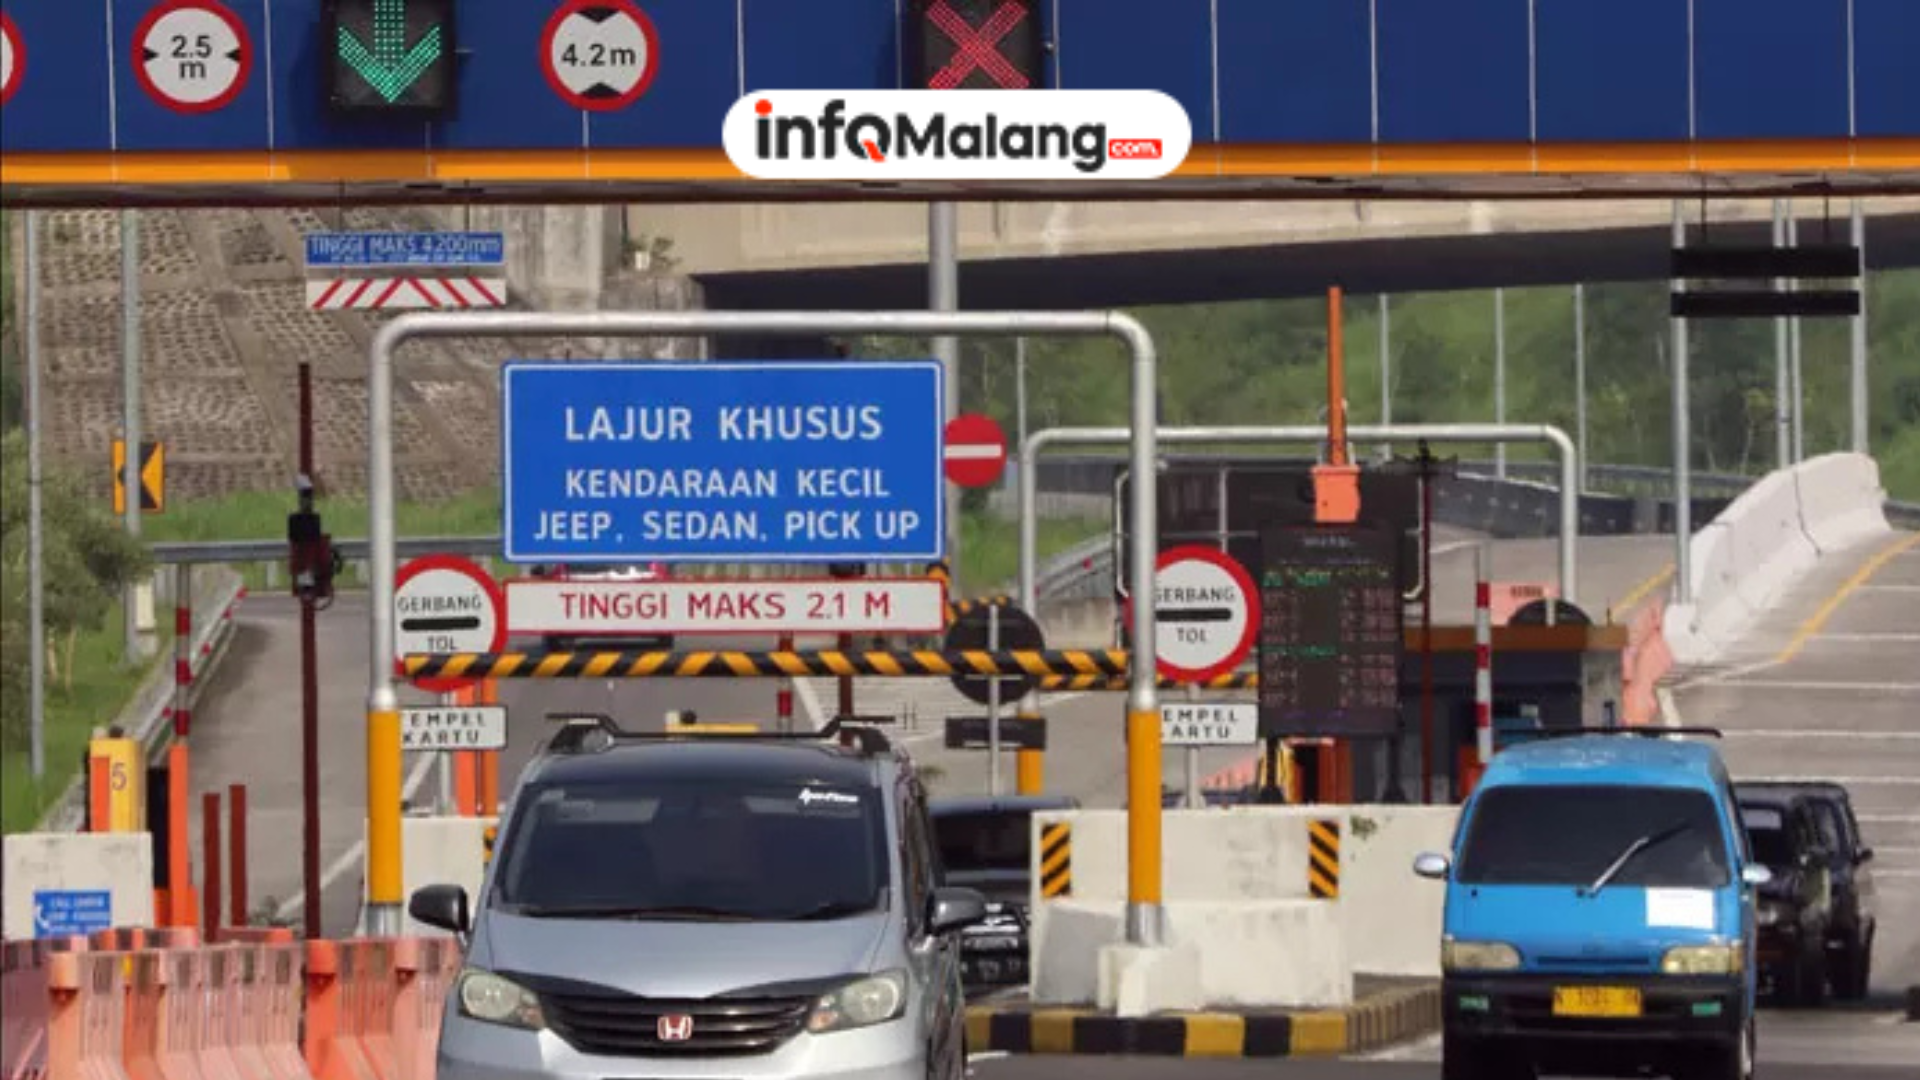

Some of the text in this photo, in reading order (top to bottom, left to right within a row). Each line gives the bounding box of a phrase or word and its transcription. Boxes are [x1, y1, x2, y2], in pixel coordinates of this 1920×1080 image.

[171, 34, 212, 59] 2.5
[179, 61, 206, 79] m
[370, 235, 418, 253] MAKS
[565, 405, 883, 441] LAJUR KHUSUS
[566, 468, 890, 498] KENDARAAN KECIL
[785, 510, 861, 540] PICK
[875, 510, 919, 540] UP
[398, 594, 482, 613] GERBANG
[560, 593, 668, 619] TINGGI
[687, 593, 786, 619] MAKS
[864, 591, 890, 619] M
[427, 635, 458, 651] TOL
[1176, 627, 1208, 644] TOL
[112, 762, 127, 791] 5
